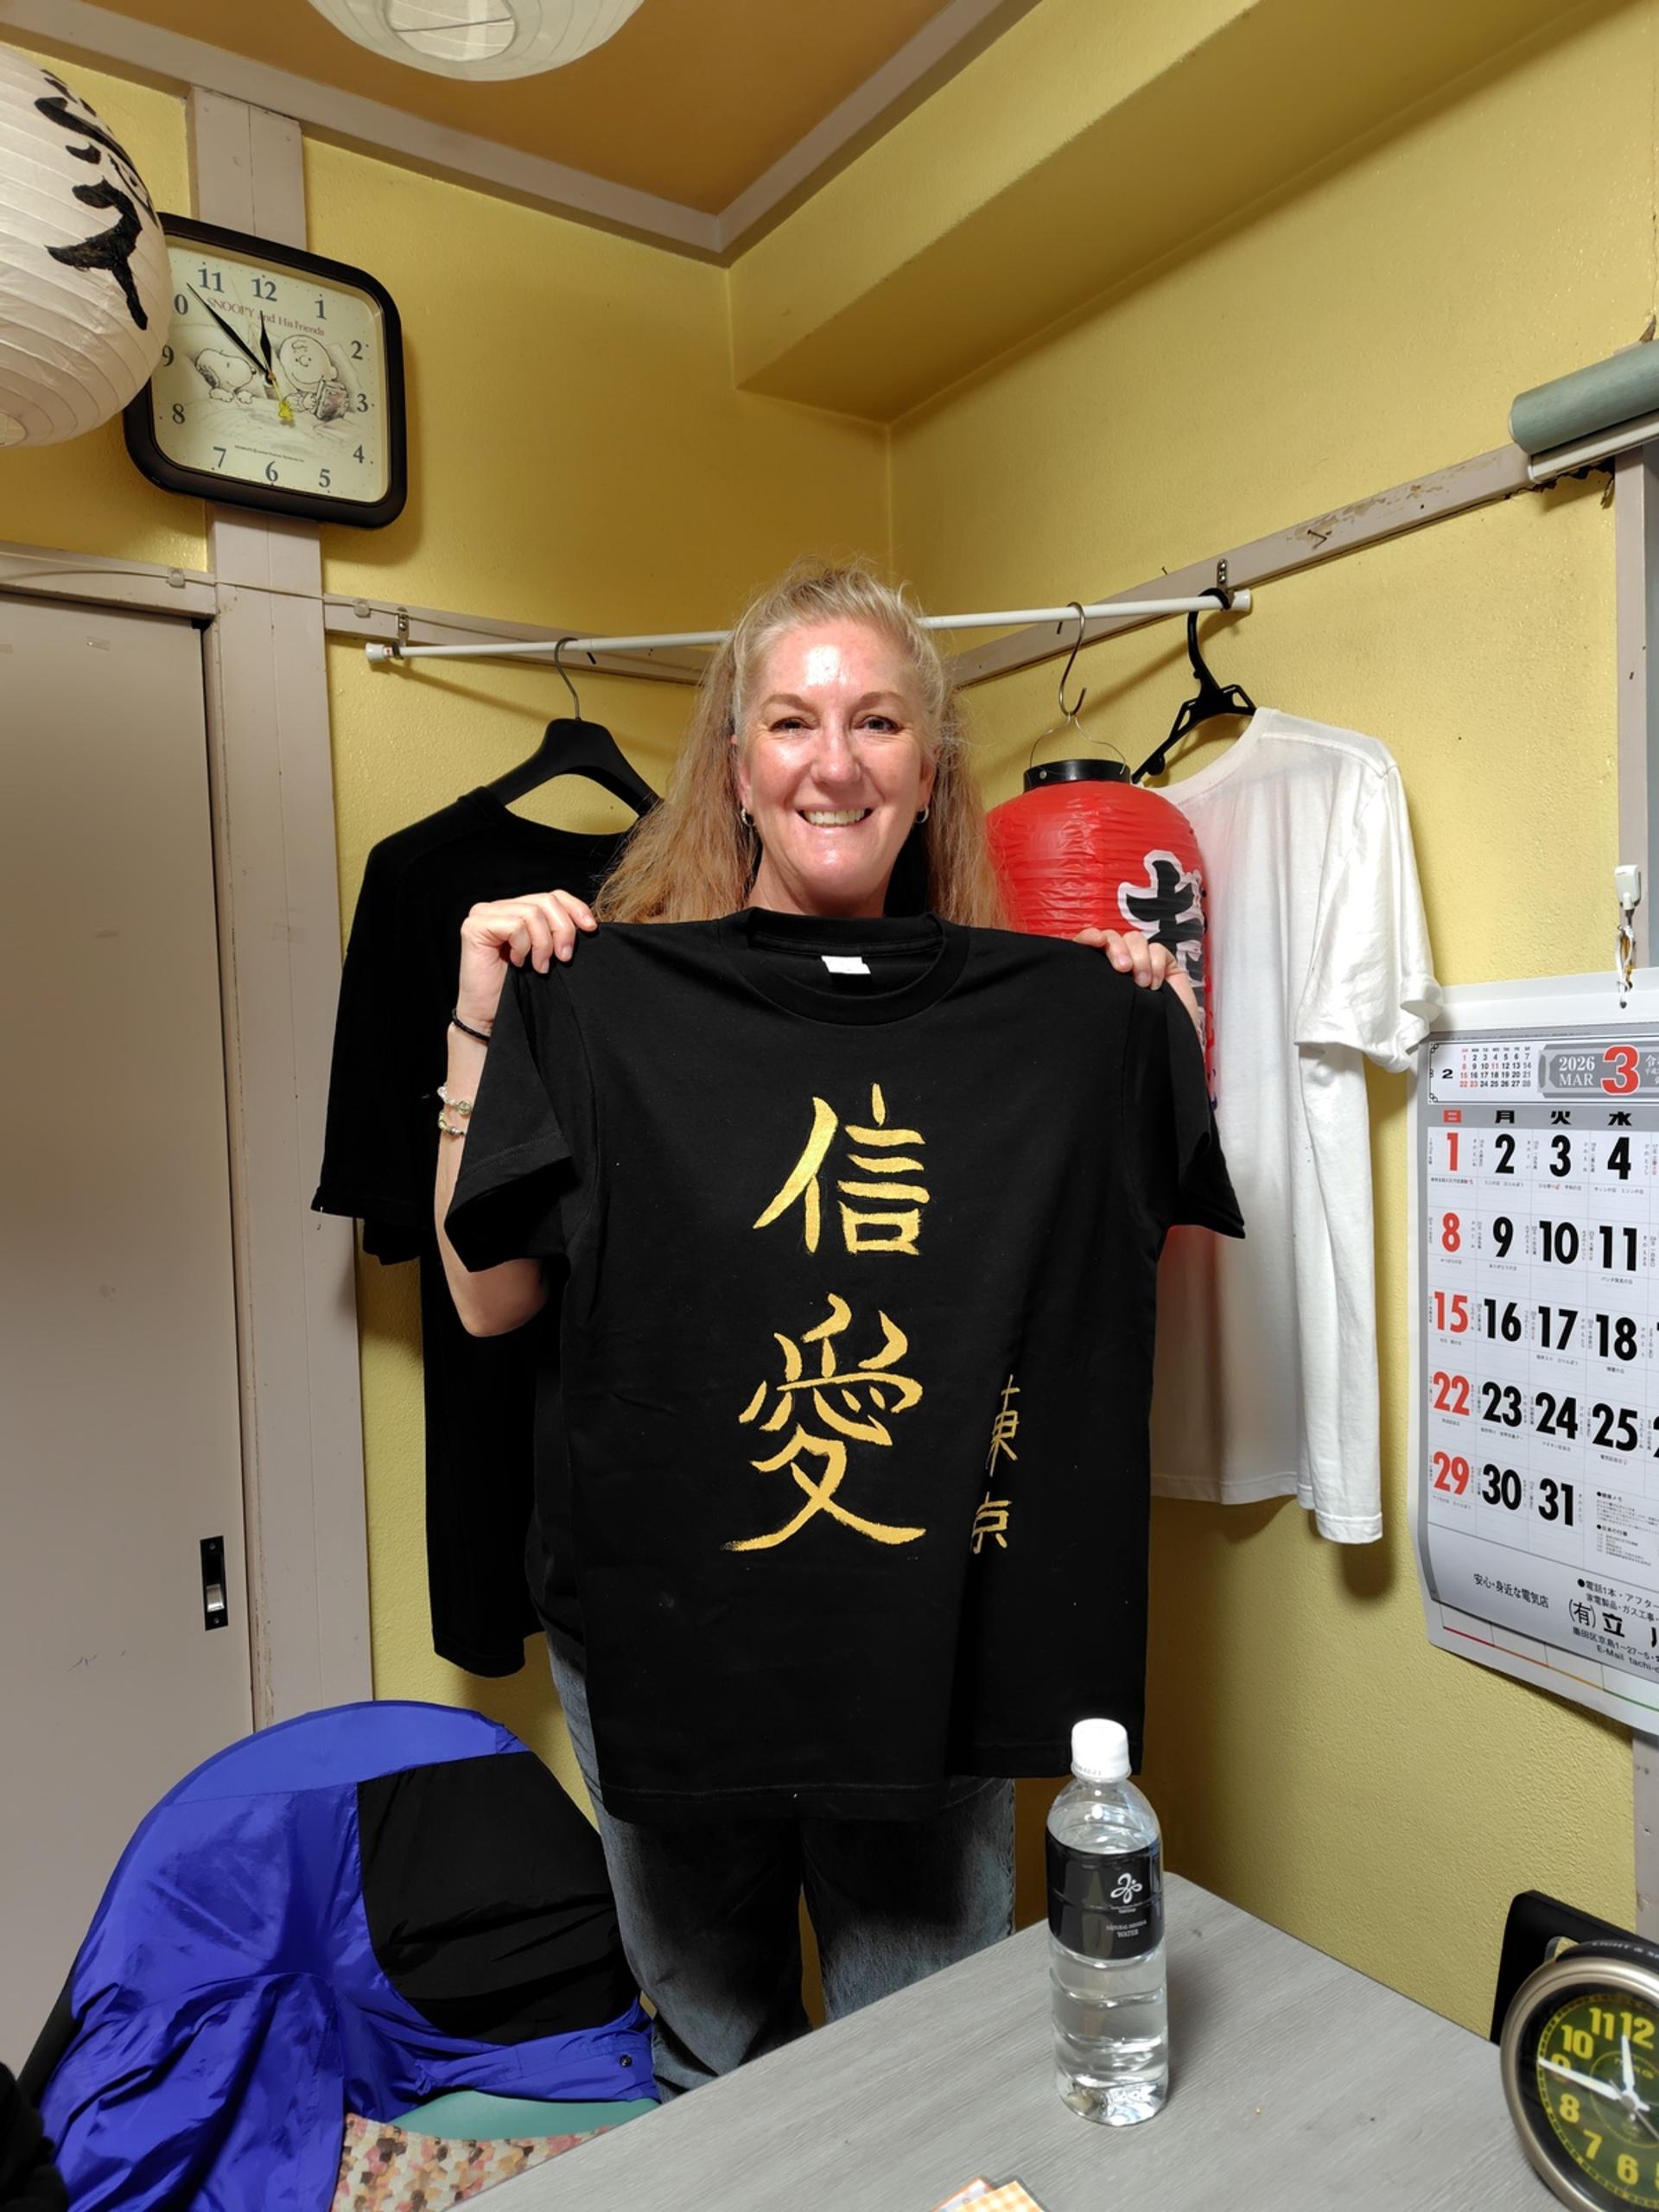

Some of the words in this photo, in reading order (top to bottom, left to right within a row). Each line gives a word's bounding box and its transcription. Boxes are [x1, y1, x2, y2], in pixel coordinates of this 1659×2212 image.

[197, 268, 225, 293] 11
[251, 278, 277, 302] 12
[173, 294, 188, 315] 0
[207, 297, 255, 317] SNOOPY
[315, 299, 327, 320] 1
[162, 346, 175, 366] 9
[351, 340, 364, 359] 2
[172, 403, 186, 424] 8
[356, 393, 369, 412] 3
[213, 446, 227, 468] 7
[353, 444, 365, 464] 4
[265, 461, 279, 482] 6
[319, 468, 331, 488] 5
[1441, 1068, 1453, 1079] 2
[1559, 1056, 1595, 1071] 2026
[1600, 1044, 1641, 1096] 3
[1559, 1072, 1594, 1086] MAR
[1443, 1109, 1462, 1123] 日
[1495, 1109, 1515, 1123] 月
[1550, 1110, 1572, 1125] 火
[1607, 1111, 1632, 1126] 水
[1446, 1132, 1459, 1172] 1
[1495, 1133, 1516, 1174] 2
[1549, 1135, 1571, 1177] 3
[1607, 1136, 1631, 1179] 4
[1441, 1211, 1461, 1253] 8
[1492, 1216, 1514, 1258] 9
[1539, 1220, 1580, 1265] 10
[1599, 1224, 1637, 1272] 11
[721, 1083, 930, 1552] 信愛
[1433, 1291, 1468, 1333] 15
[1484, 1298, 1522, 1342] 16
[1538, 1305, 1579, 1351] 17
[1595, 1313, 1637, 1361] 18
[1433, 1370, 1470, 1416] 22
[1482, 1381, 1522, 1427] 23
[1535, 1391, 1578, 1440] 24
[1592, 1402, 1638, 1452] 25
[1433, 1451, 1470, 1496] 29
[1482, 1463, 1522, 1510] 30
[1538, 1478, 1573, 1527] 31
[1596, 1644, 1624, 1661] E-Mail
[1589, 2007, 1615, 2041] 11
[1620, 2012, 1655, 2050] 12
[1560, 2024, 1594, 2060] 10
[1559, 2093, 1580, 2124] 8
[1582, 2128, 1603, 2160] 7
[1617, 2152, 1639, 2185] 6
